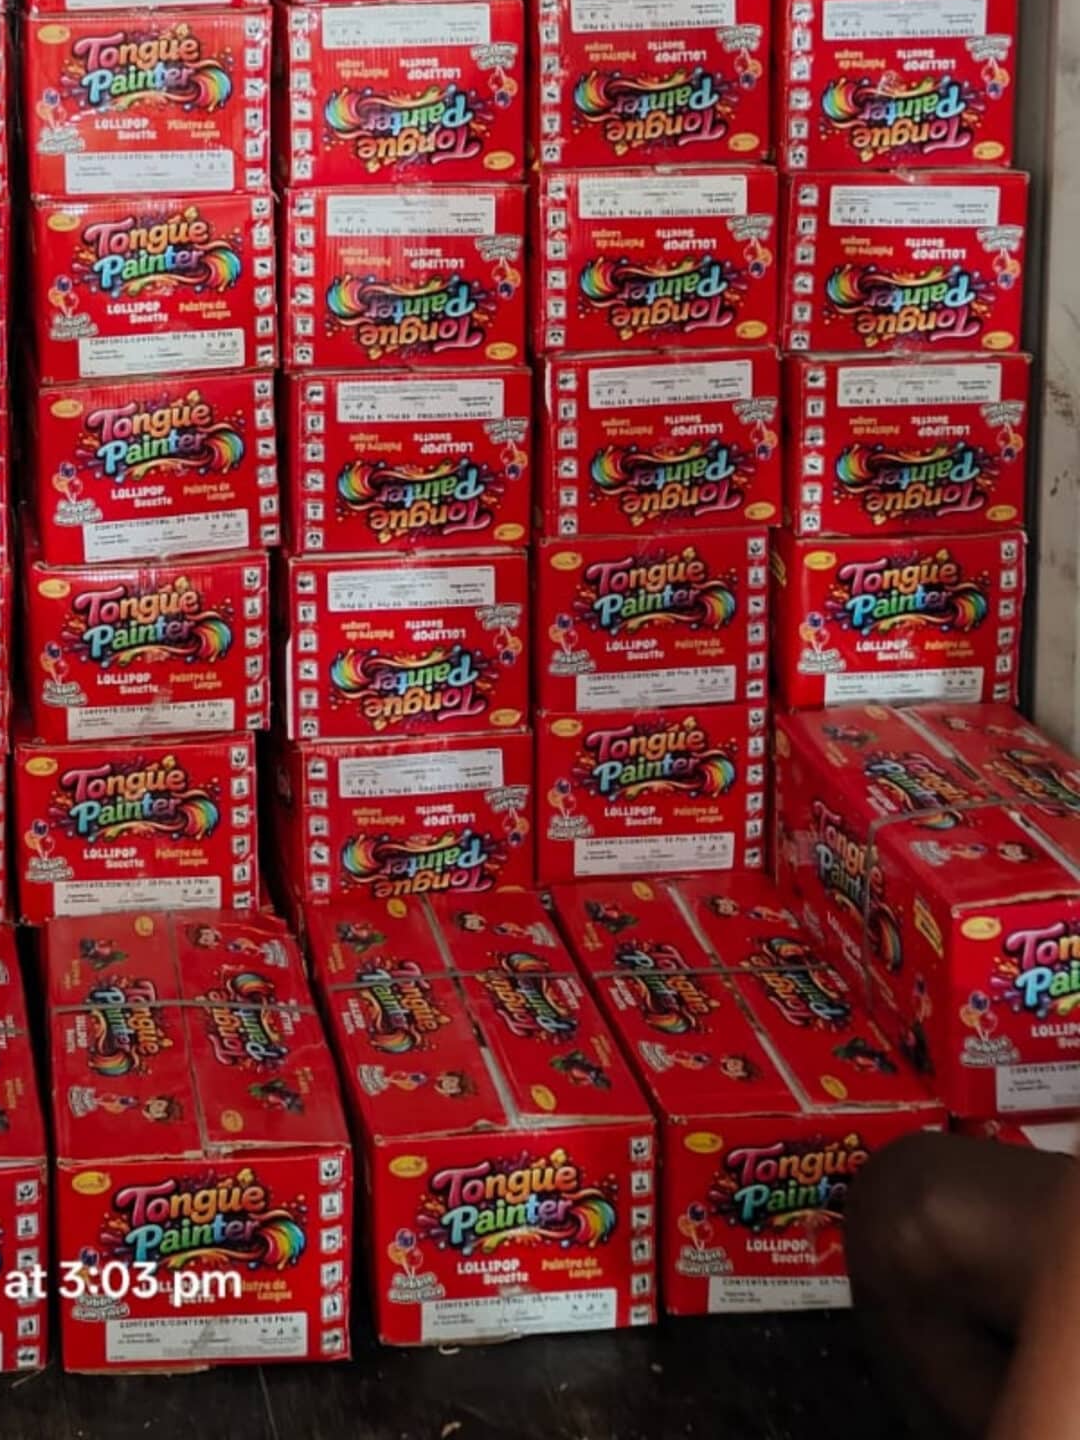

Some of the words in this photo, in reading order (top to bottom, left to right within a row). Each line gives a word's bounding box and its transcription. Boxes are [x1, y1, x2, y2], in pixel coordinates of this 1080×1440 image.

[74, 32, 198, 70] Tongue
[83, 62, 194, 105] Painter
[610, 75, 718, 118] Painter
[94, 118, 150, 132] LOLLIPOP
[606, 110, 726, 147] Tongue
[85, 217, 208, 254] Tongue
[94, 245, 204, 290] Painter
[616, 263, 726, 304] Painter
[106, 301, 162, 316] LOLLIPOP
[611, 296, 733, 333] Tongue
[916, 424, 970, 437] LOLLIPOP
[374, 465, 484, 507] Painter
[871, 449, 979, 489] Painter
[369, 499, 492, 536] Tongue
[865, 482, 985, 517] Tongue
[586, 557, 704, 593] Tongue
[840, 558, 957, 594] Tongue
[594, 584, 701, 627] Painter
[846, 586, 953, 627] Painter
[605, 638, 658, 653] LOLLIPOP
[727, 1142, 868, 1186] Tongue
[116, 1180, 265, 1224] Tongue
[432, 1162, 577, 1205] Tongue
[127, 1214, 260, 1264] Painter
[442, 1194, 572, 1246] Painter
[746, 1239, 810, 1253] LOLLIPOP
[456, 1258, 521, 1276] LOLLIPOP
